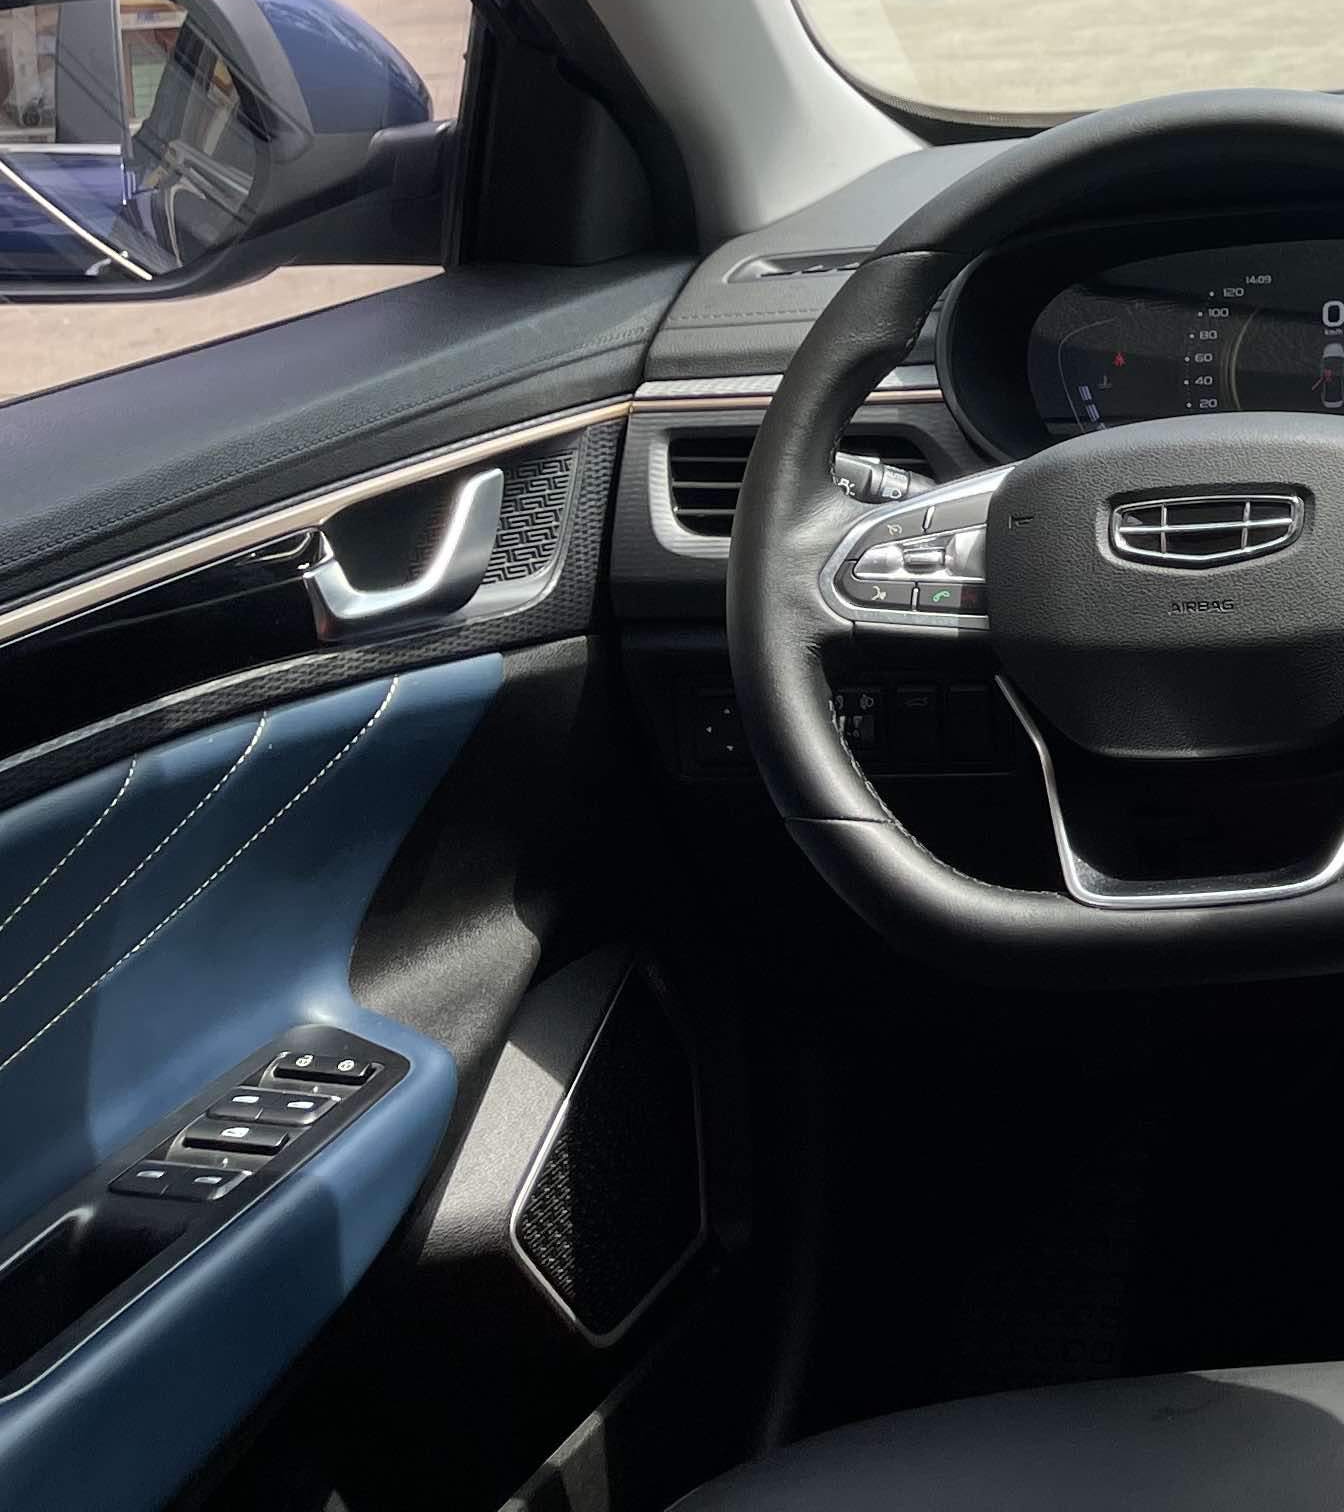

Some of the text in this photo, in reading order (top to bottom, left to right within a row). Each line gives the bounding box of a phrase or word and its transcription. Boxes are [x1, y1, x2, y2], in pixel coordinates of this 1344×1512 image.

[1223, 287, 1245, 298] 120
[1208, 307, 1230, 318] 100
[1199, 329, 1219, 340] 80
[1194, 352, 1214, 363] 60
[1194, 375, 1214, 386] 40
[1199, 398, 1218, 409] 20
[1168, 598, 1235, 616] AIRBAG
